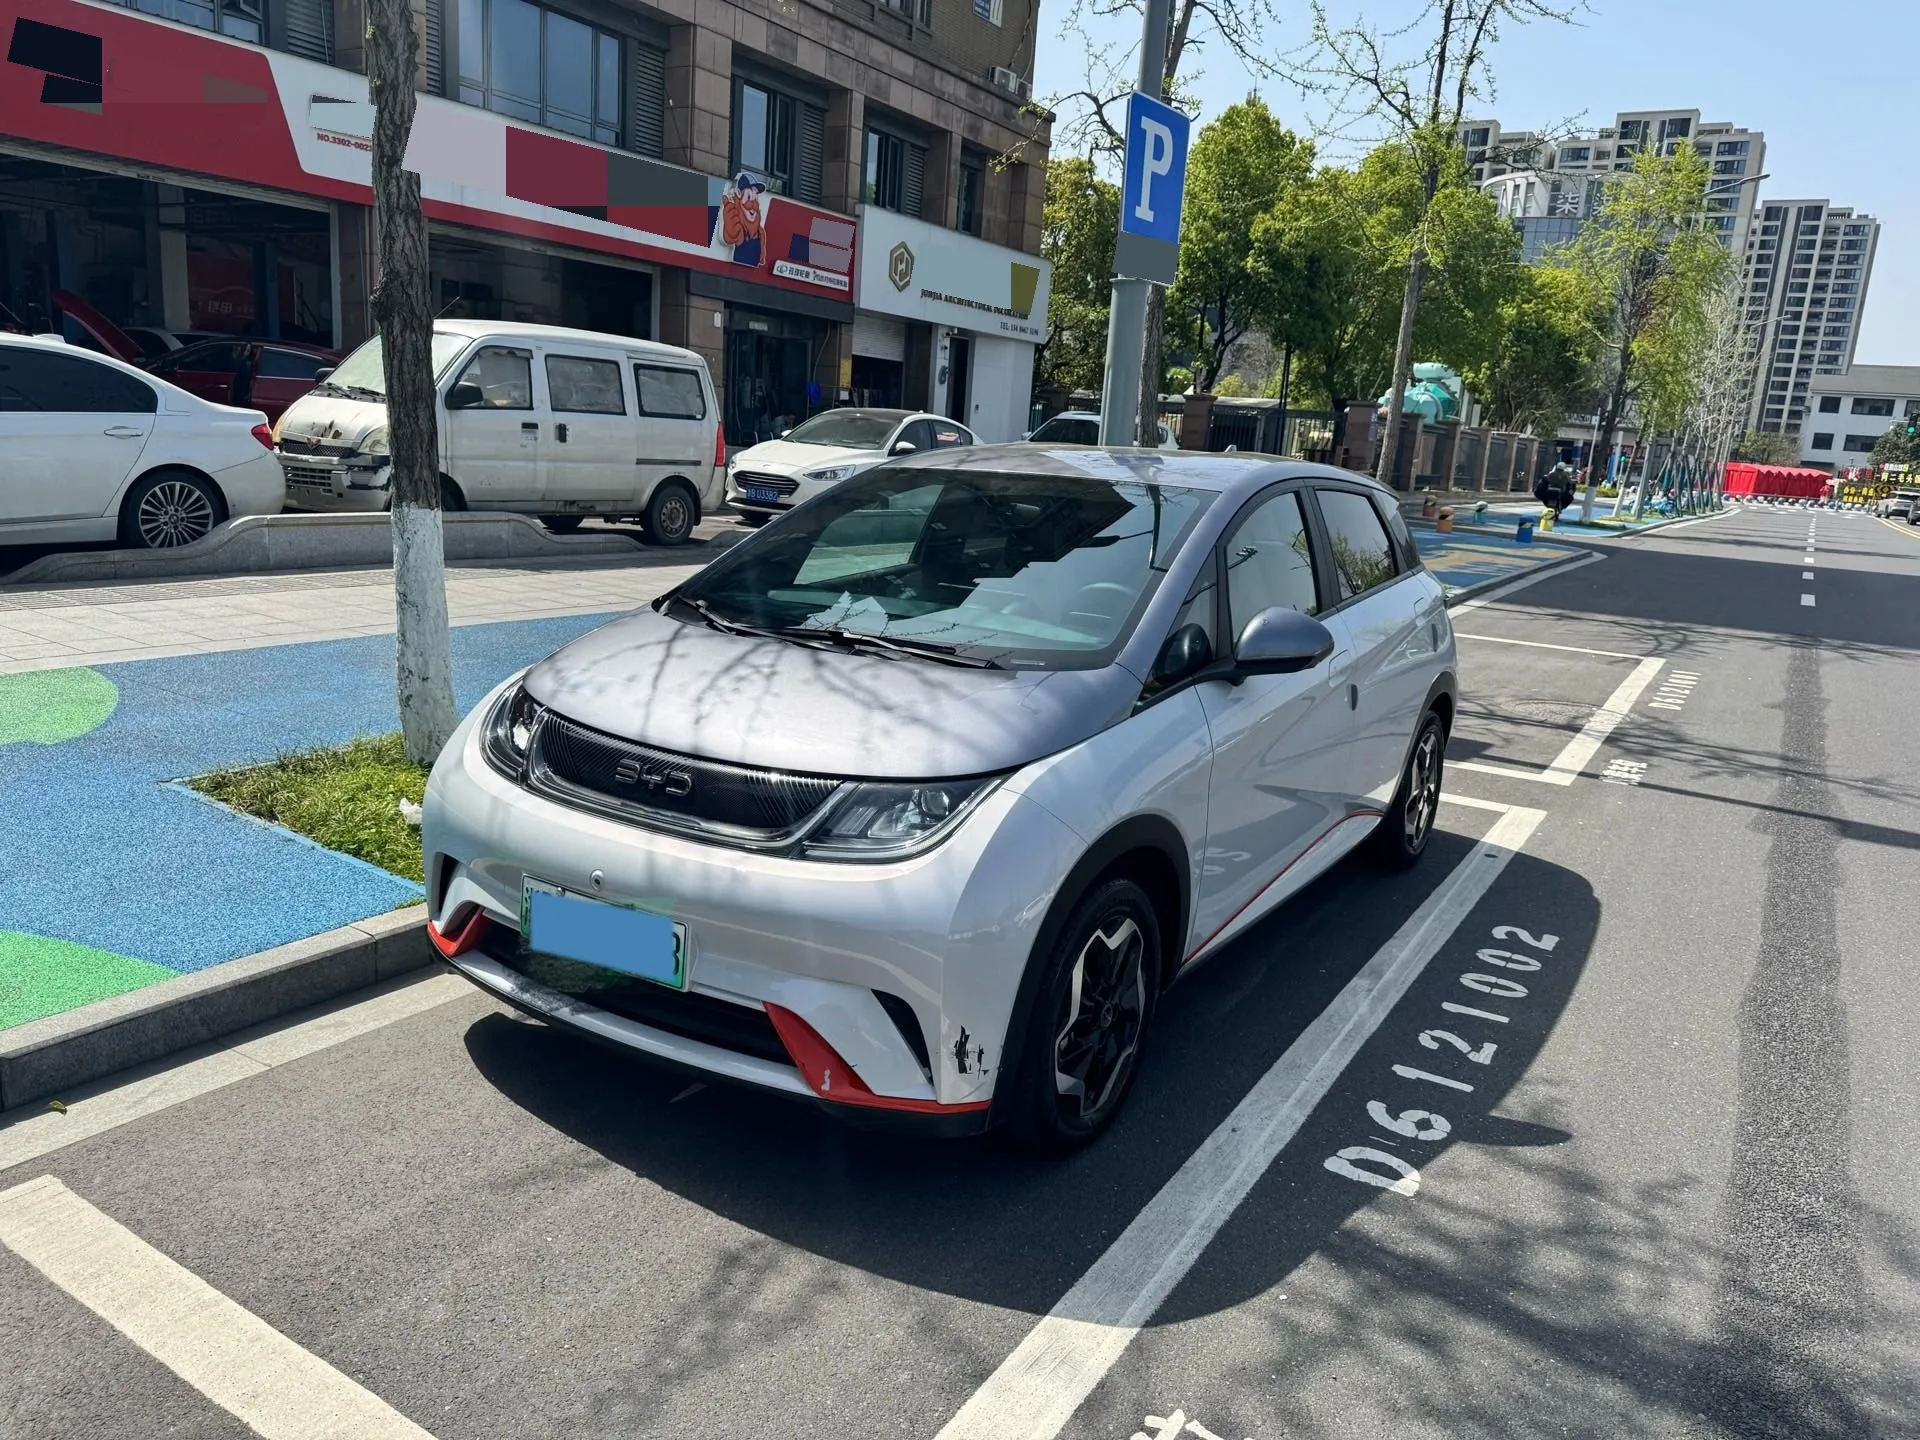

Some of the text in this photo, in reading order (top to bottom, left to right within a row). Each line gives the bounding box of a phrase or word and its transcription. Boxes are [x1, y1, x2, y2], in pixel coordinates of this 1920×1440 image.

[1135, 115, 1173, 223] P
[613, 758, 693, 797] BYD
[1323, 925, 1560, 1197] D6121002
